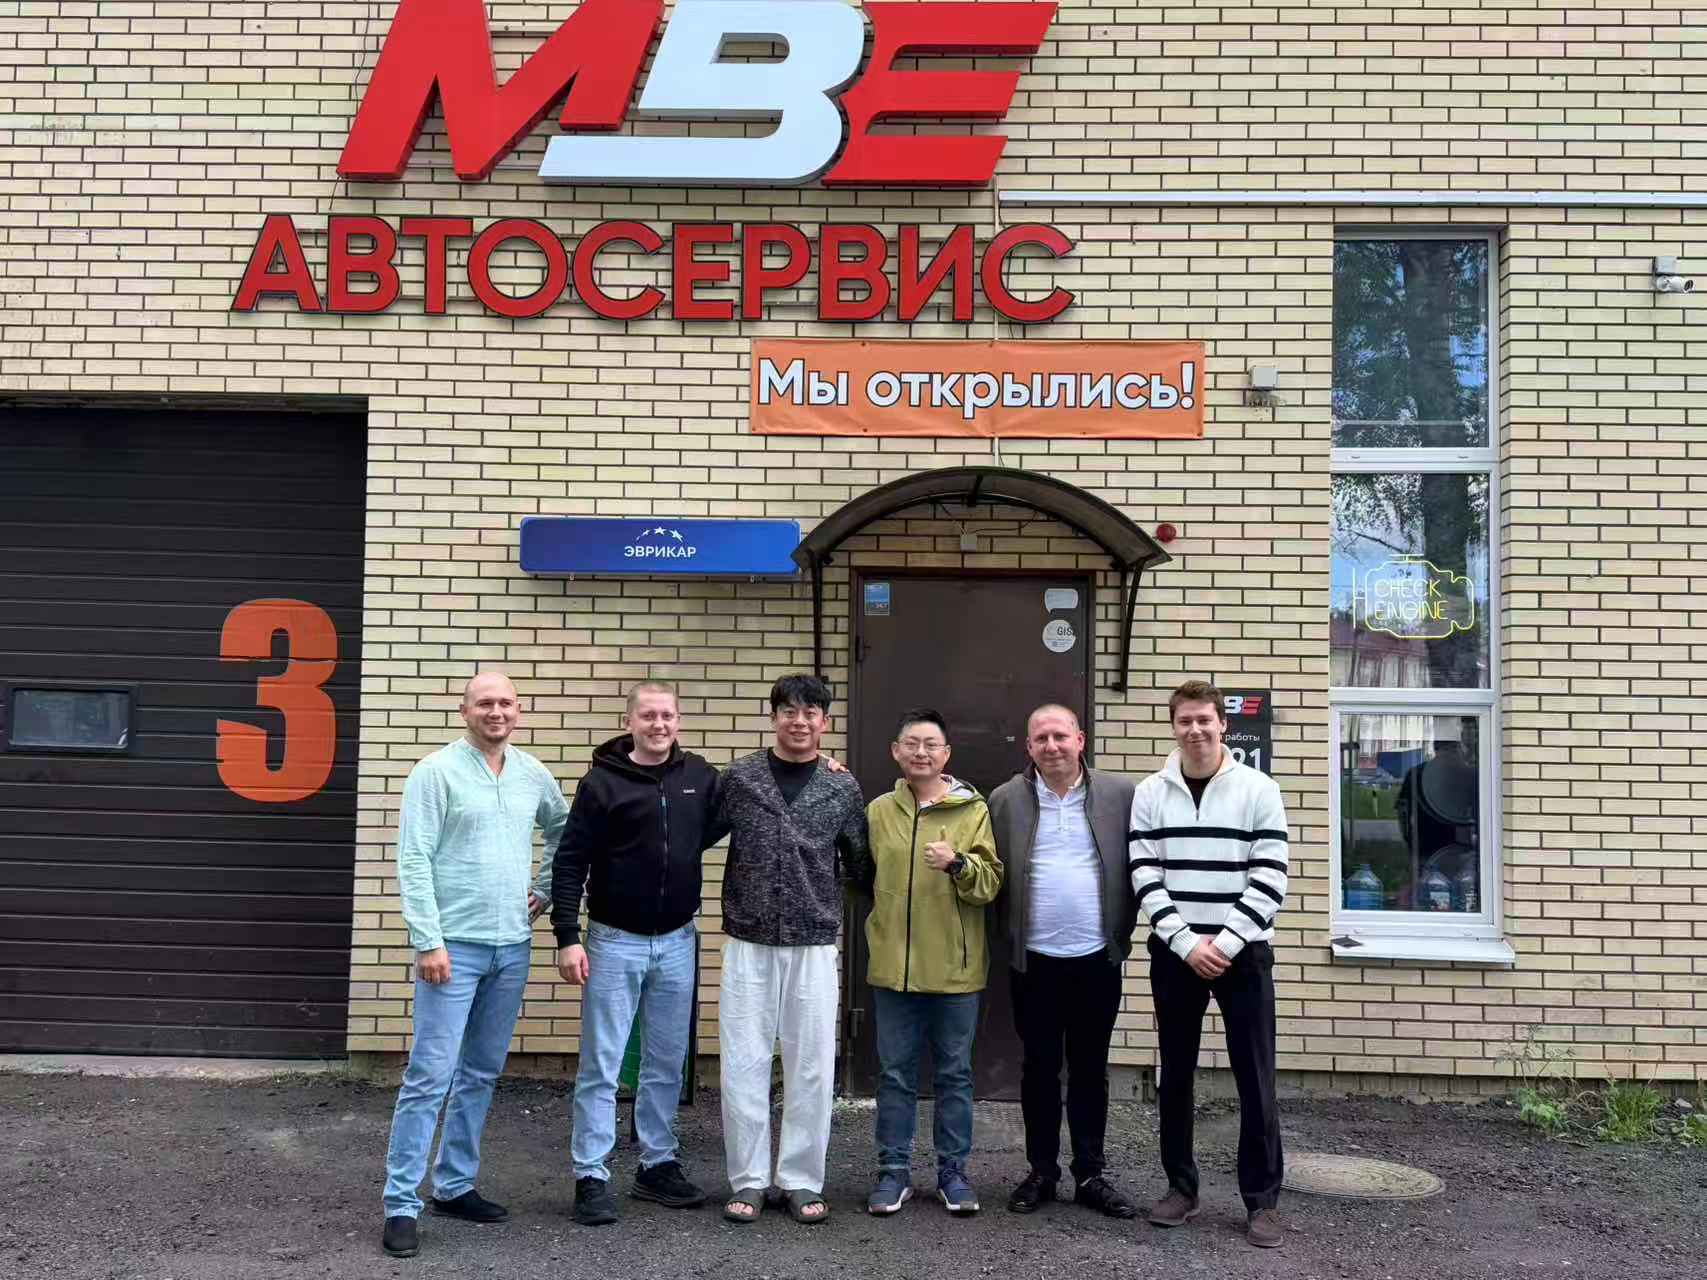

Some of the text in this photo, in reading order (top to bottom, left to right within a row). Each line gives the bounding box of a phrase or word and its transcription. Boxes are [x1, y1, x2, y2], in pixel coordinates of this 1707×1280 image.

[230, 214, 1077, 324] АВТОСЕРВИС
[758, 357, 1196, 419] Мы открылись!
[623, 545, 697, 558] ЭВРИКАР
[1374, 578, 1441, 598] CHECK
[1374, 600, 1449, 620] ENGINE
[216, 597, 338, 802] 3
[1225, 731, 1260, 743] работы
